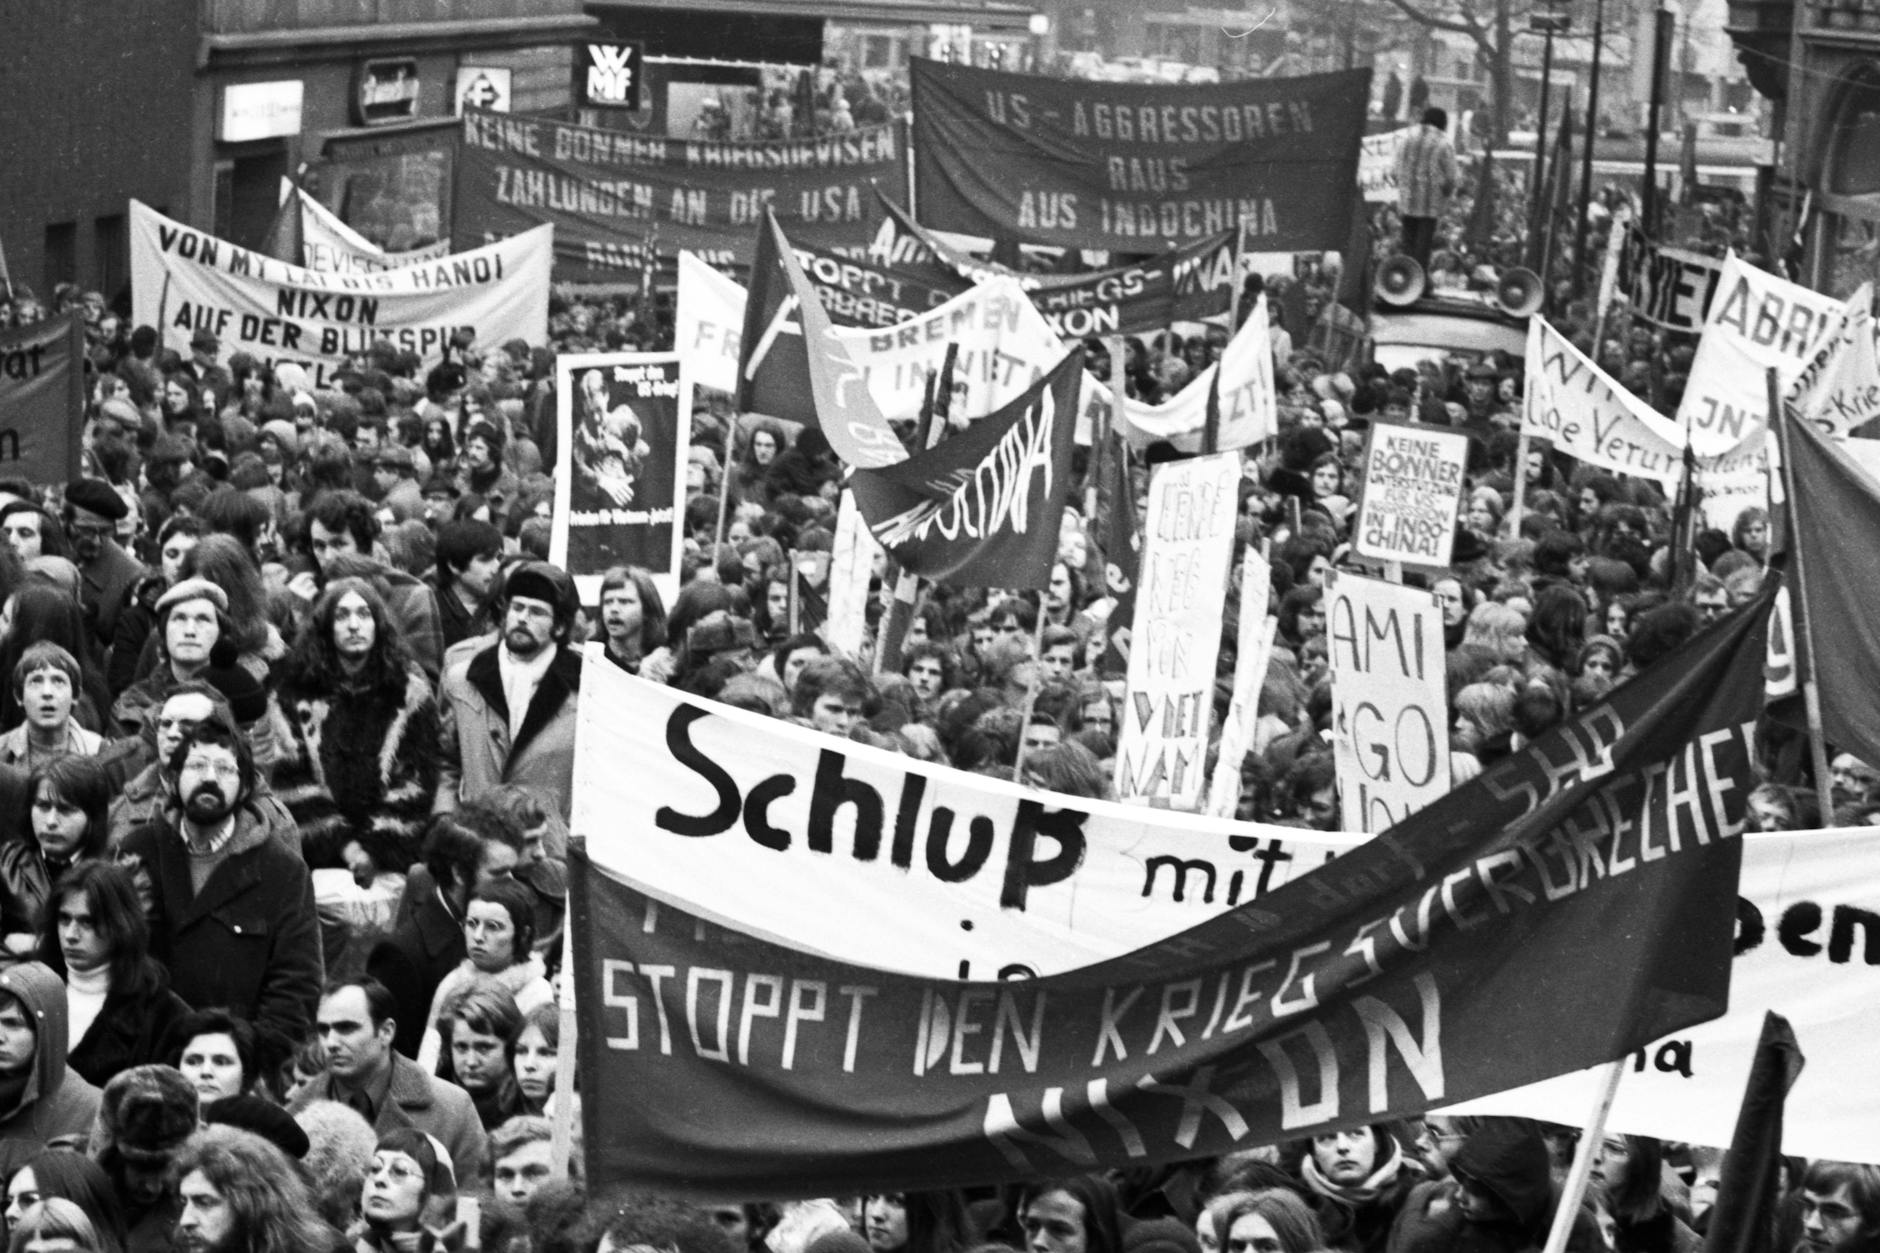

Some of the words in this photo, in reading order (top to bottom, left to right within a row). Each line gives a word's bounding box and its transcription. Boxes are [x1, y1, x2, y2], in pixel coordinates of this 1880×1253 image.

[464, 112, 541, 158] KEINE
[1074, 101, 1314, 143] AGGRESSOREN
[495, 165, 652, 219] ZAHLUNGEN
[670, 187, 707, 226] AN
[802, 185, 862, 222] USA
[1107, 155, 1191, 192] RAUS
[1018, 191, 1078, 230] AUS
[1101, 199, 1279, 238] INDOCHINA
[159, 224, 218, 267] VON
[230, 248, 267, 279] MY
[412, 253, 503, 289] HANOI
[173, 300, 233, 337] AUF
[240, 315, 301, 350] DER
[277, 288, 379, 326] NIXON
[1372, 449, 1461, 484] BONNER
[1386, 436, 1440, 459] KEINE
[1365, 528, 1439, 557] CHINA!
[1332, 594, 1424, 681] AMI
[1353, 700, 1437, 788] GO
[1141, 834, 1293, 906] mit
[601, 957, 879, 1073] STOPPT
[912, 985, 1047, 1077] DEN
[983, 969, 1445, 1175] NIXON
